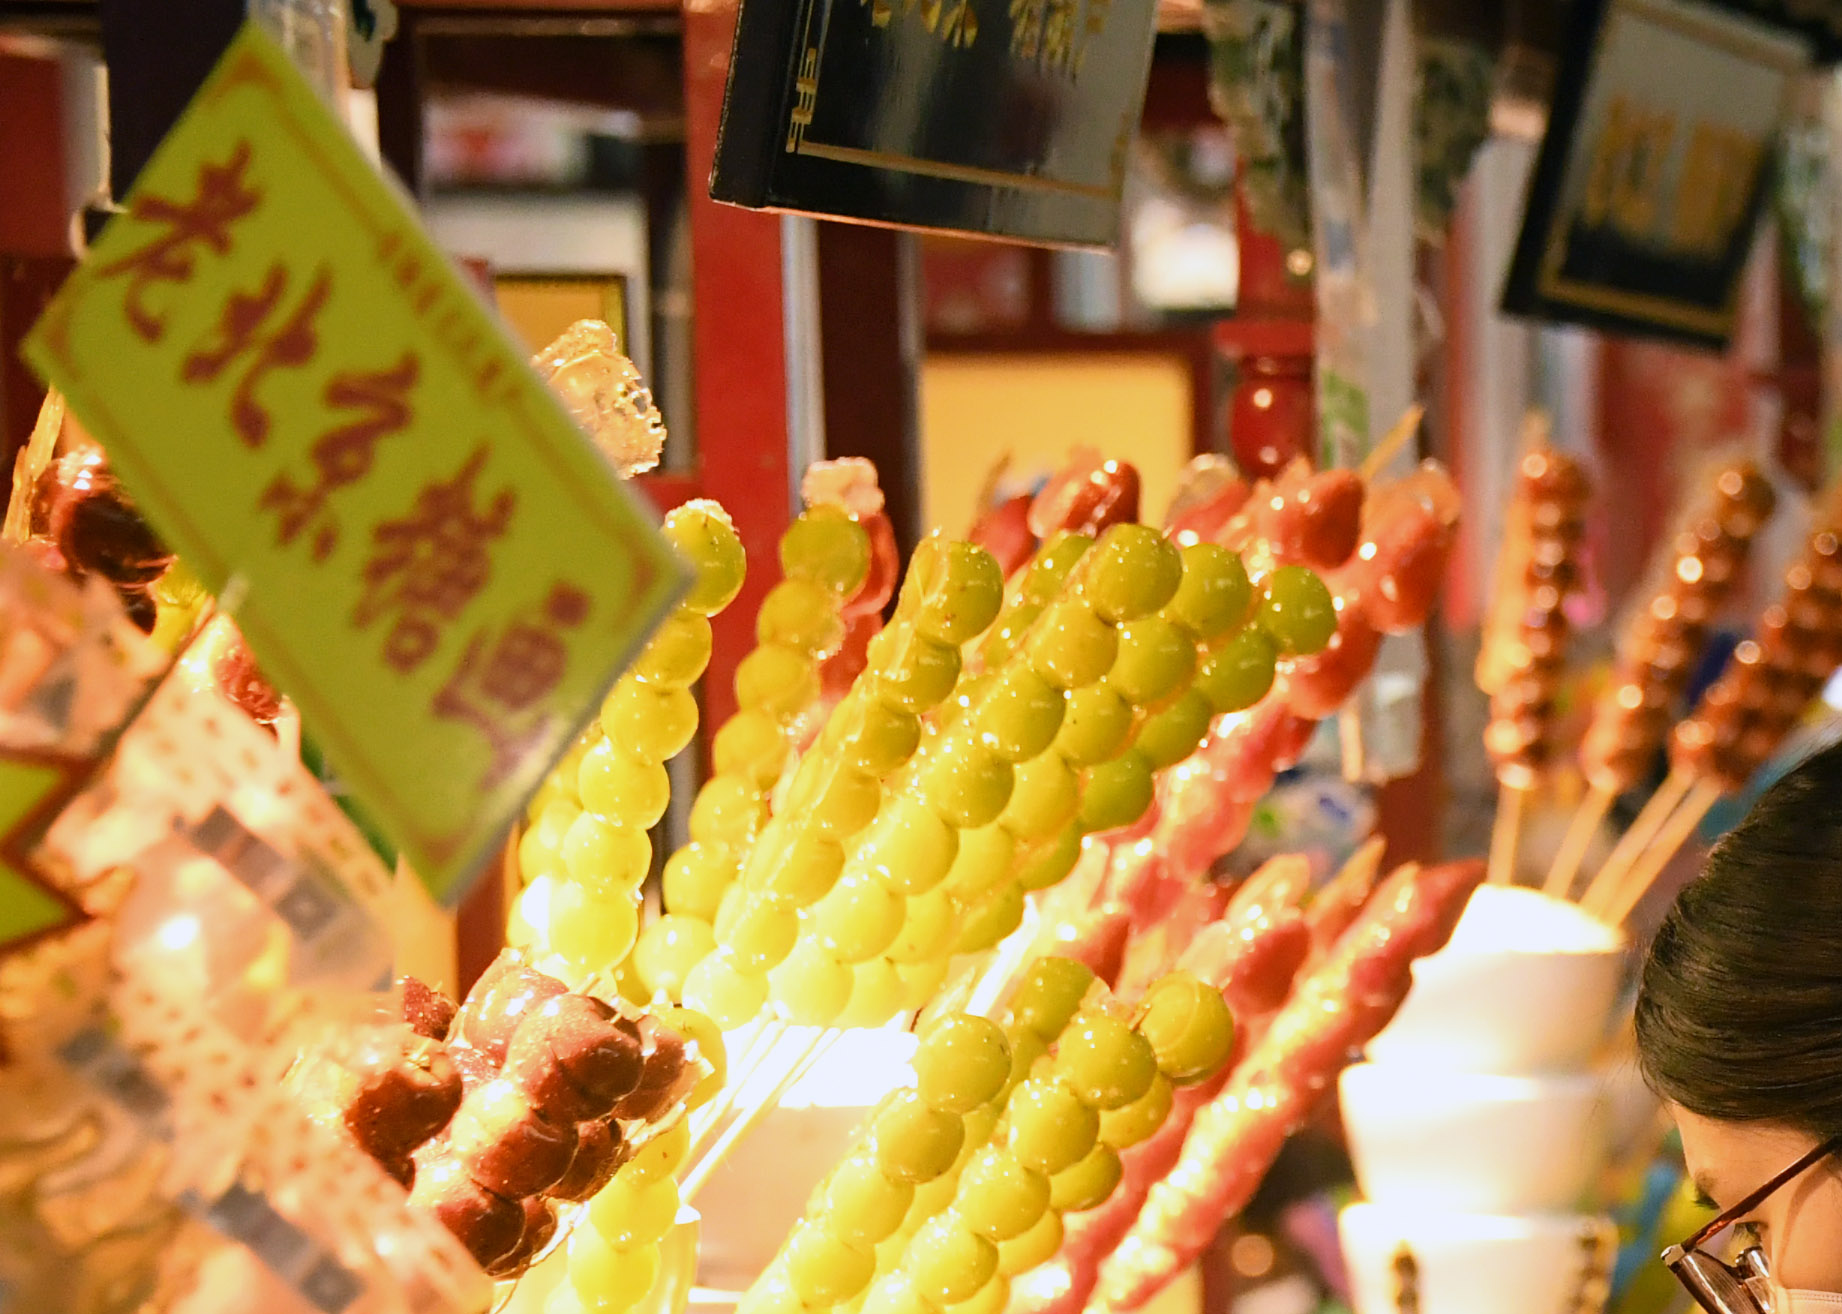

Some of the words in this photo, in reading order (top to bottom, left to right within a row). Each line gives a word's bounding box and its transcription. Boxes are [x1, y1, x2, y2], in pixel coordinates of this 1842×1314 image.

[95, 139, 597, 792] 老北京糖画
